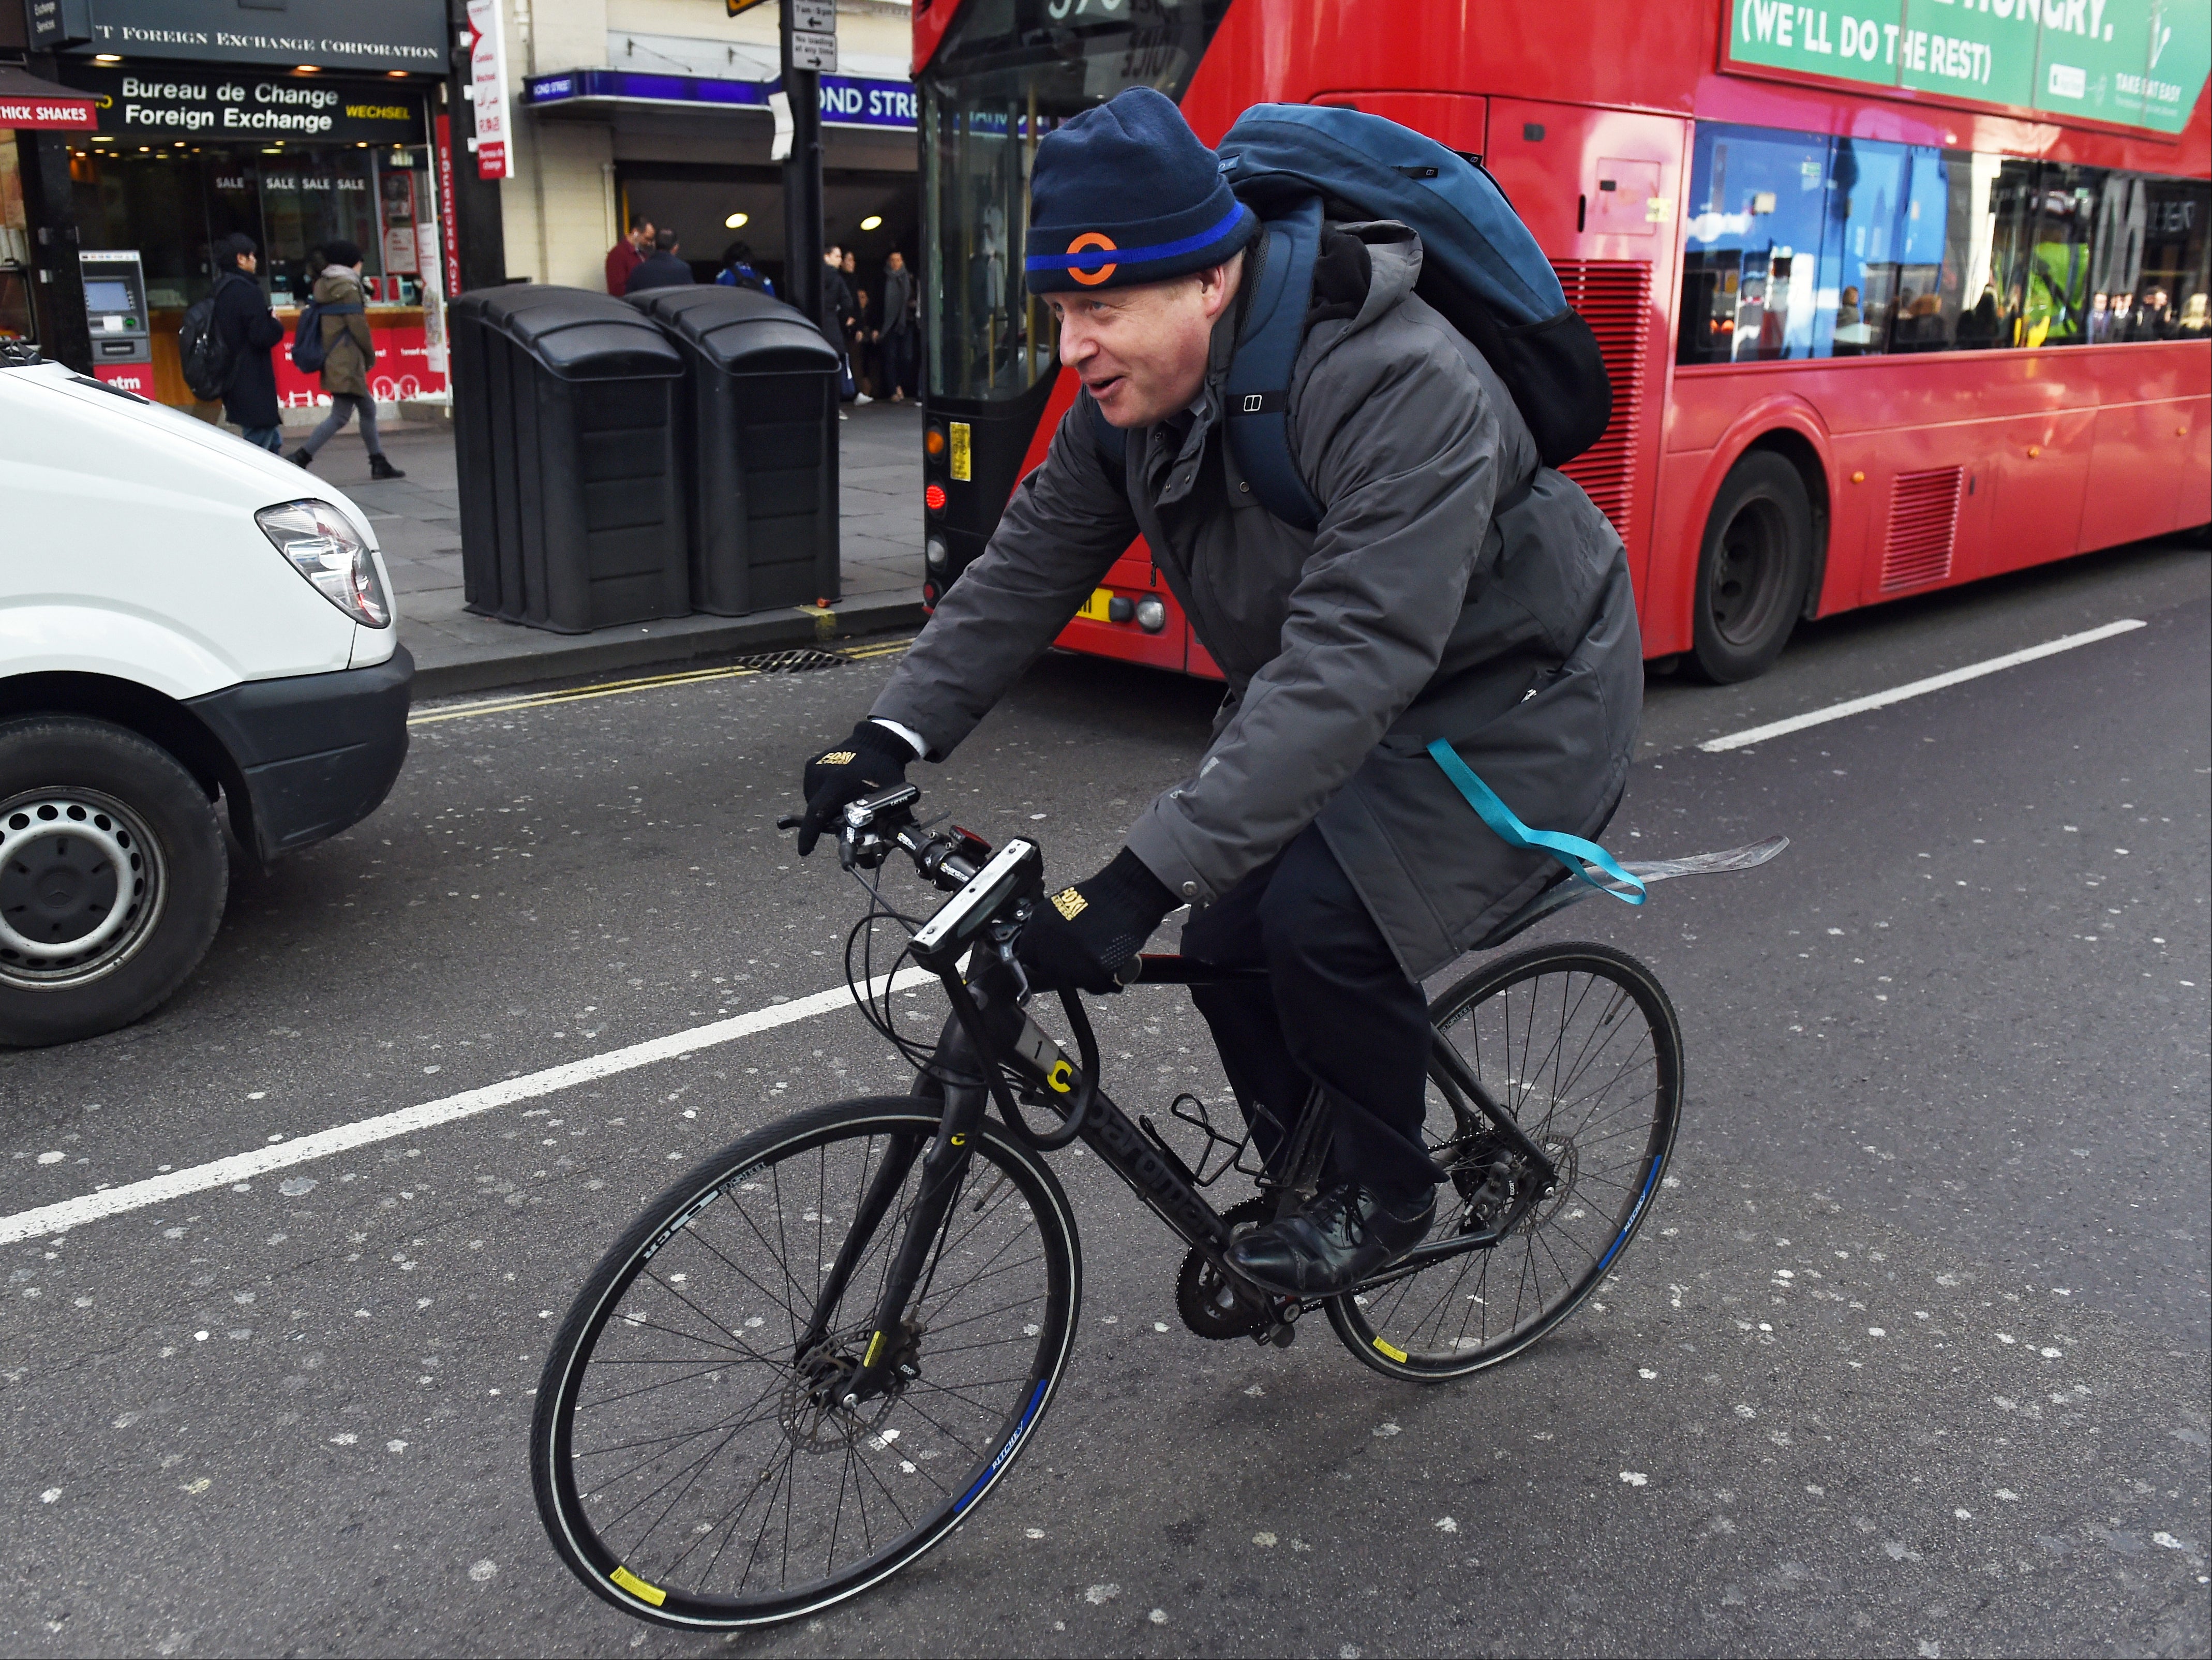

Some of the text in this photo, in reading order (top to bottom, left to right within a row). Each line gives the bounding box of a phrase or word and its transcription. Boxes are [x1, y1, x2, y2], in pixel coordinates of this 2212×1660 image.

[123, 26, 208, 45] FOREIGN
[216, 31, 315, 52] EXCHANGE
[320, 38, 439, 59] CORPORATION
[1741, 0, 1832, 54] (WE'LL
[1840, 15, 1879, 62] DO
[1884, 23, 1928, 71] THE
[1930, 35, 1992, 85] REST)
[123, 77, 339, 109] Bureau de Change
[36, 107, 87, 121] SHAKES
[125, 104, 333, 134] Foreign Exchange
[346, 105, 411, 120] WECHSEL
[216, 177, 365, 190] SALE SALE SALE SALE
[440, 146, 458, 298] ncy exchange
[107, 376, 141, 390] atm
[1623, 1190, 1646, 1233] RITCHEY
[992, 1420, 1023, 1470] RITCHEY
